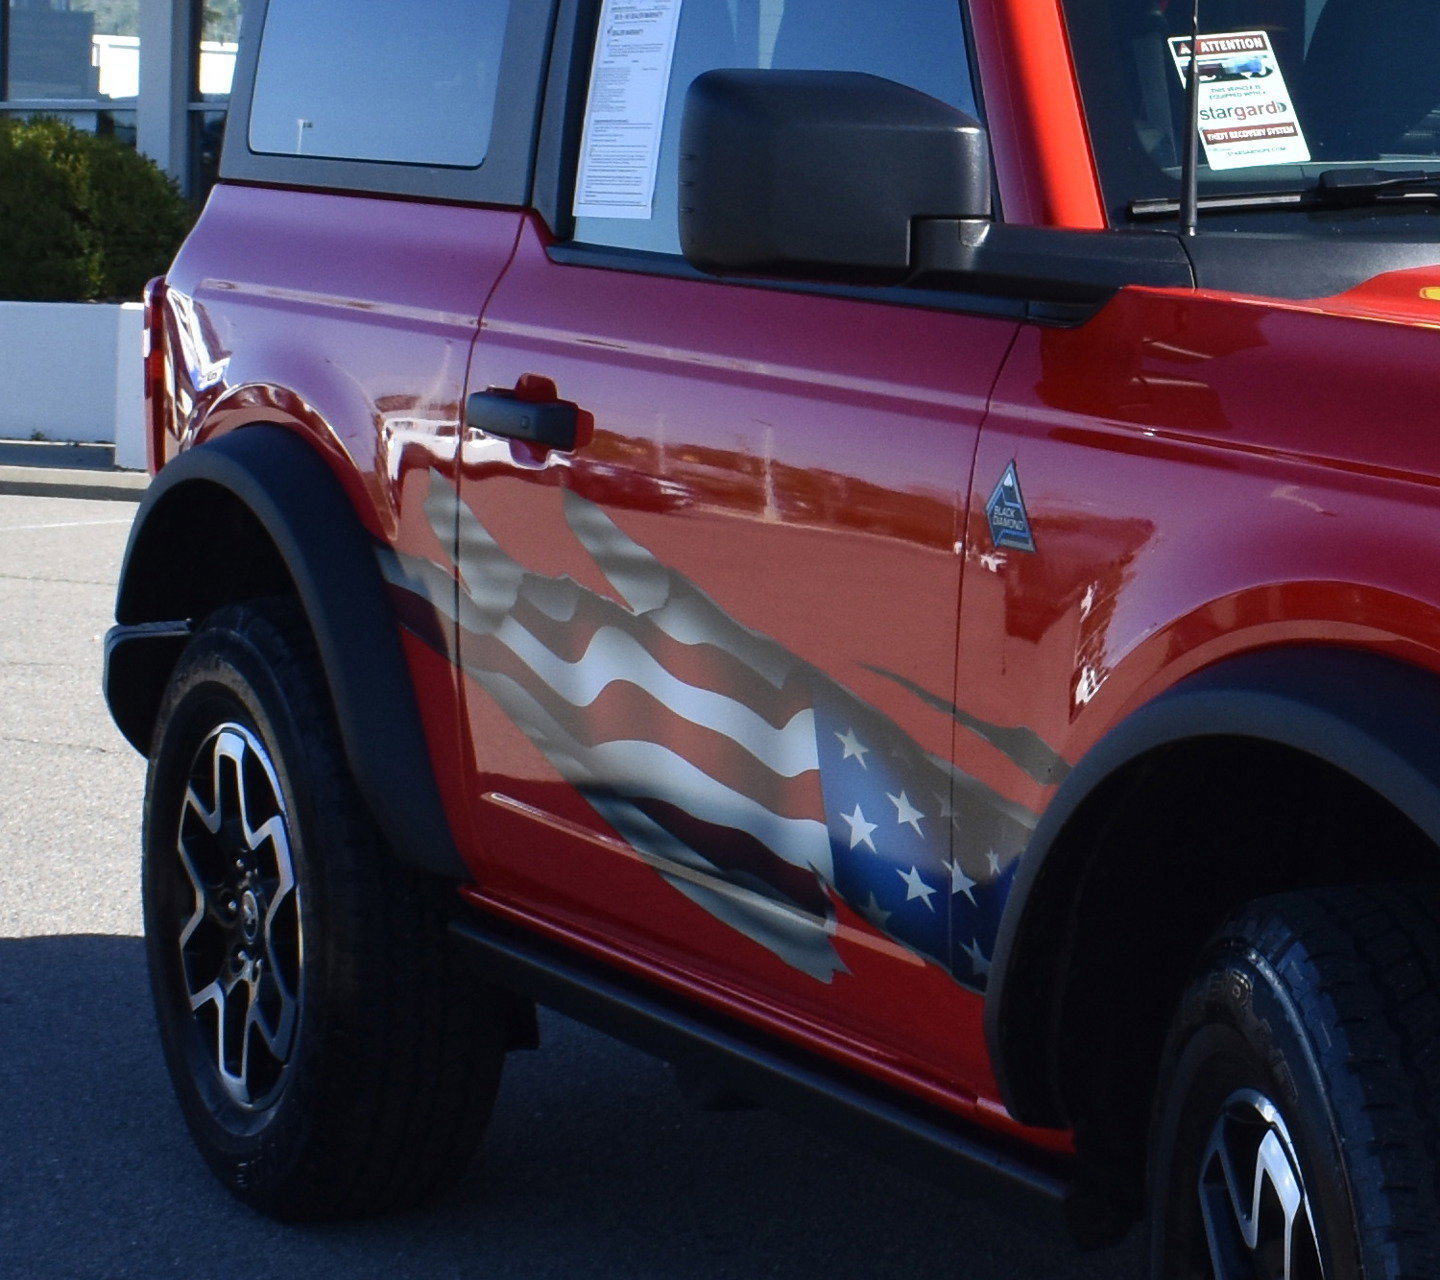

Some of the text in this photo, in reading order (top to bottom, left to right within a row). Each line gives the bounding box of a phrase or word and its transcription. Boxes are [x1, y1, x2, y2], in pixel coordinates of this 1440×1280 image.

[1200, 36, 1264, 53] ATTENTION
[1200, 101, 1278, 121] stargard
[994, 505, 1015, 518] BLACK
[992, 515, 1025, 531] DIAMOND
